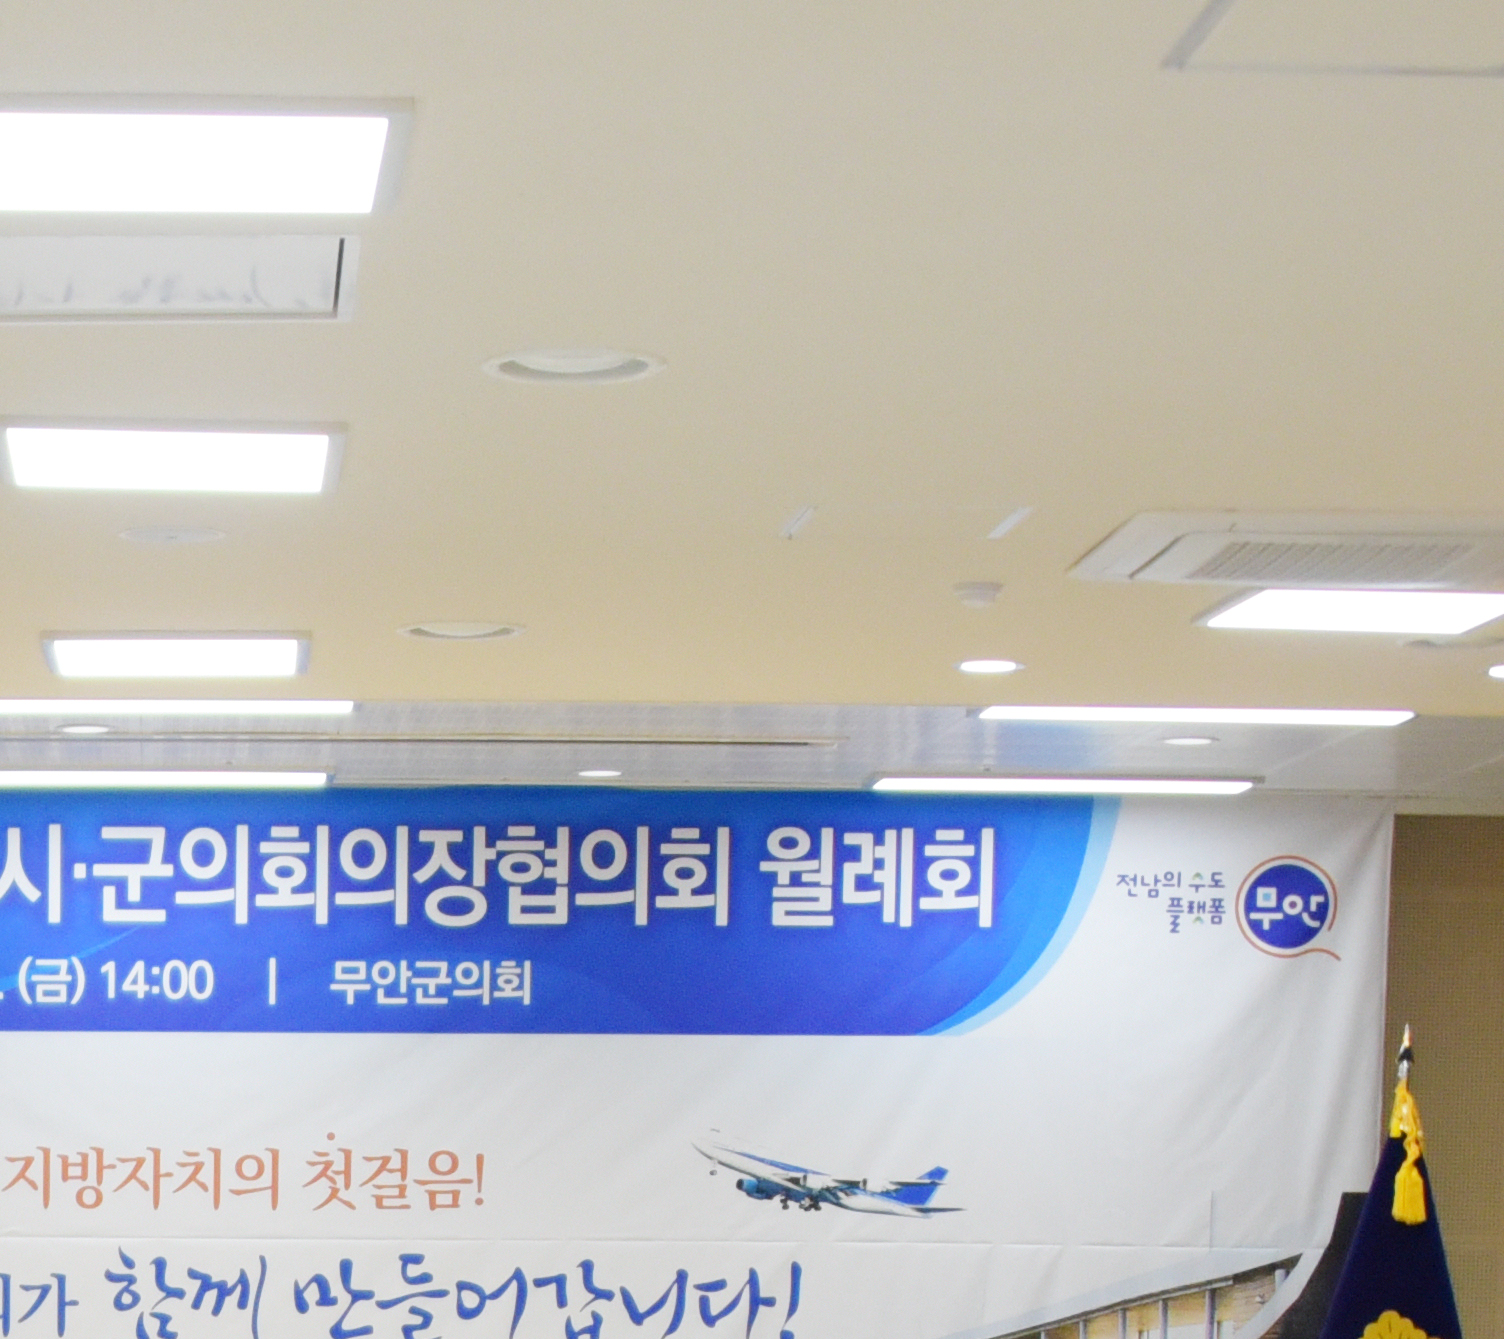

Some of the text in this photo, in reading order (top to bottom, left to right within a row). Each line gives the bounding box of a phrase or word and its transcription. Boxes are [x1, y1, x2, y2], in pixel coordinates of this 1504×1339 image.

[760, 827, 995, 928] 월례회
[1116, 871, 1226, 899] 전남의 수도
[1249, 886, 1326, 931] 무안
[19, 956, 86, 1005] (금)
[101, 959, 215, 1001] 14:00
[329, 959, 532, 1006] 무안군의회
[3, 1146, 280, 1211] 지방자치의
[303, 1132, 485, 1212] 첫걸음!
